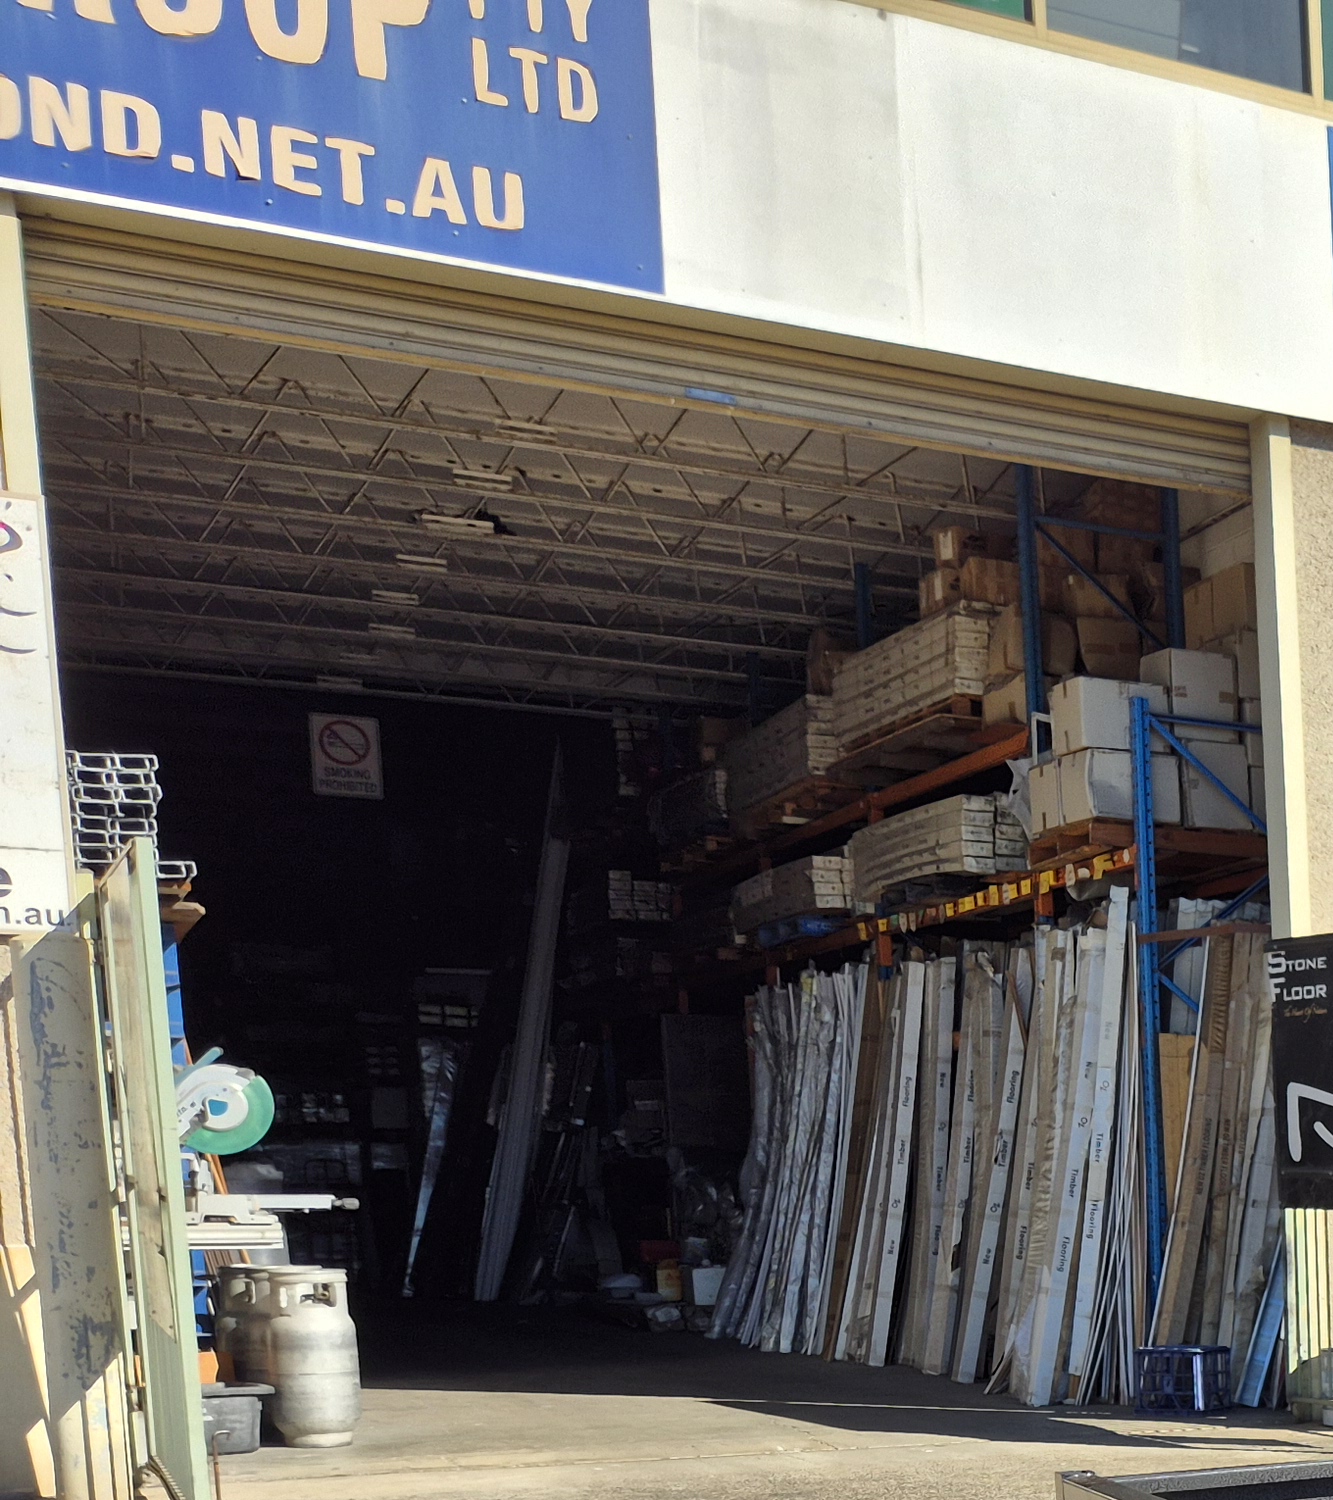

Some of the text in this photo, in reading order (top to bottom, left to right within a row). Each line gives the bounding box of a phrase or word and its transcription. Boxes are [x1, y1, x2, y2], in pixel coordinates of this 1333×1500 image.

[471, 38, 600, 122] LTD
[318, 778, 377, 793] PROHIBITED
[324, 766, 371, 780] SMOKING
[897, 1140, 906, 1165] Timber
[902, 1076, 912, 1107] Flooring
[999, 1140, 1008, 1167] Timber
[1006, 1070, 1019, 1103] Flooring
[1095, 1133, 1103, 1163] Timber
[1025, 1162, 1034, 1190] Timber
[1068, 1169, 1078, 1198] Timber
[1087, 1203, 1098, 1239] Flooring
[1017, 1226, 1027, 1260] Flooring
[1057, 1236, 1070, 1273] Flooring
